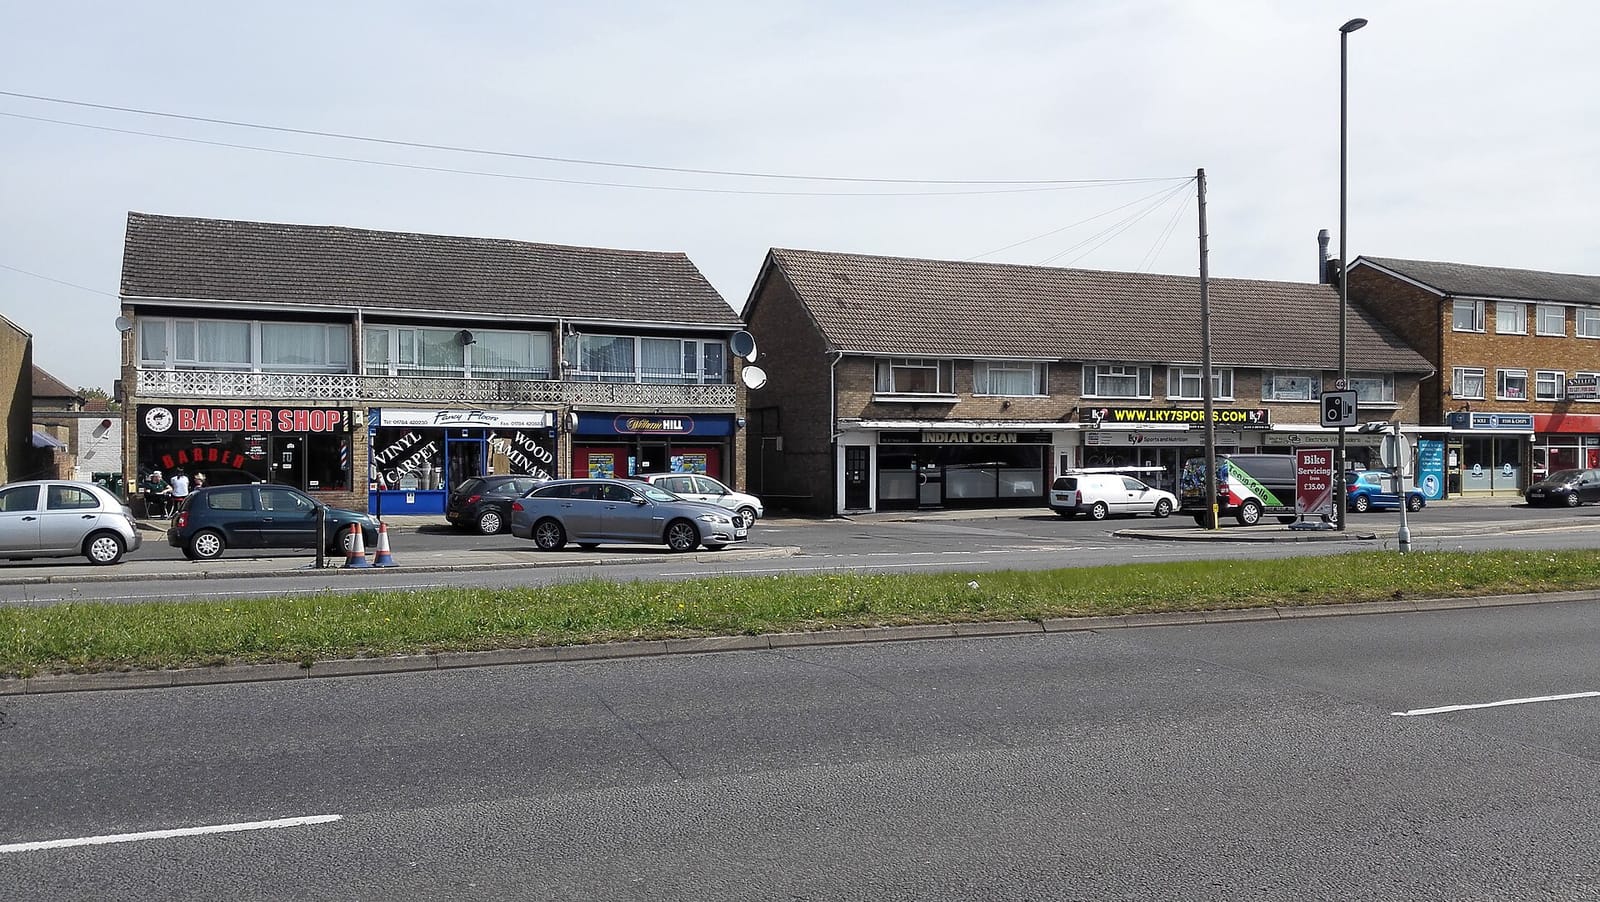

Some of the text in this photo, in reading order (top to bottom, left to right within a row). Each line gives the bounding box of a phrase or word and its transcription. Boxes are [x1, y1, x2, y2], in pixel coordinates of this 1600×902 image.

[177, 408, 273, 432] BARBER
[277, 409, 341, 432] SHOP
[433, 410, 463, 424] Fancy
[1114, 409, 1247, 423] WWW.LKY7SPORS.COM
[663, 419, 683, 430] HILL
[921, 432, 969, 443] INDIAN
[971, 432, 1018, 444] OCEAN
[374, 431, 422, 464] VINYL
[515, 431, 553, 464] WOOD
[161, 447, 245, 469] BARBER
[386, 441, 439, 483] CARPET
[1303, 455, 1326, 465] Bike
[1297, 467, 1331, 476] Servicing
